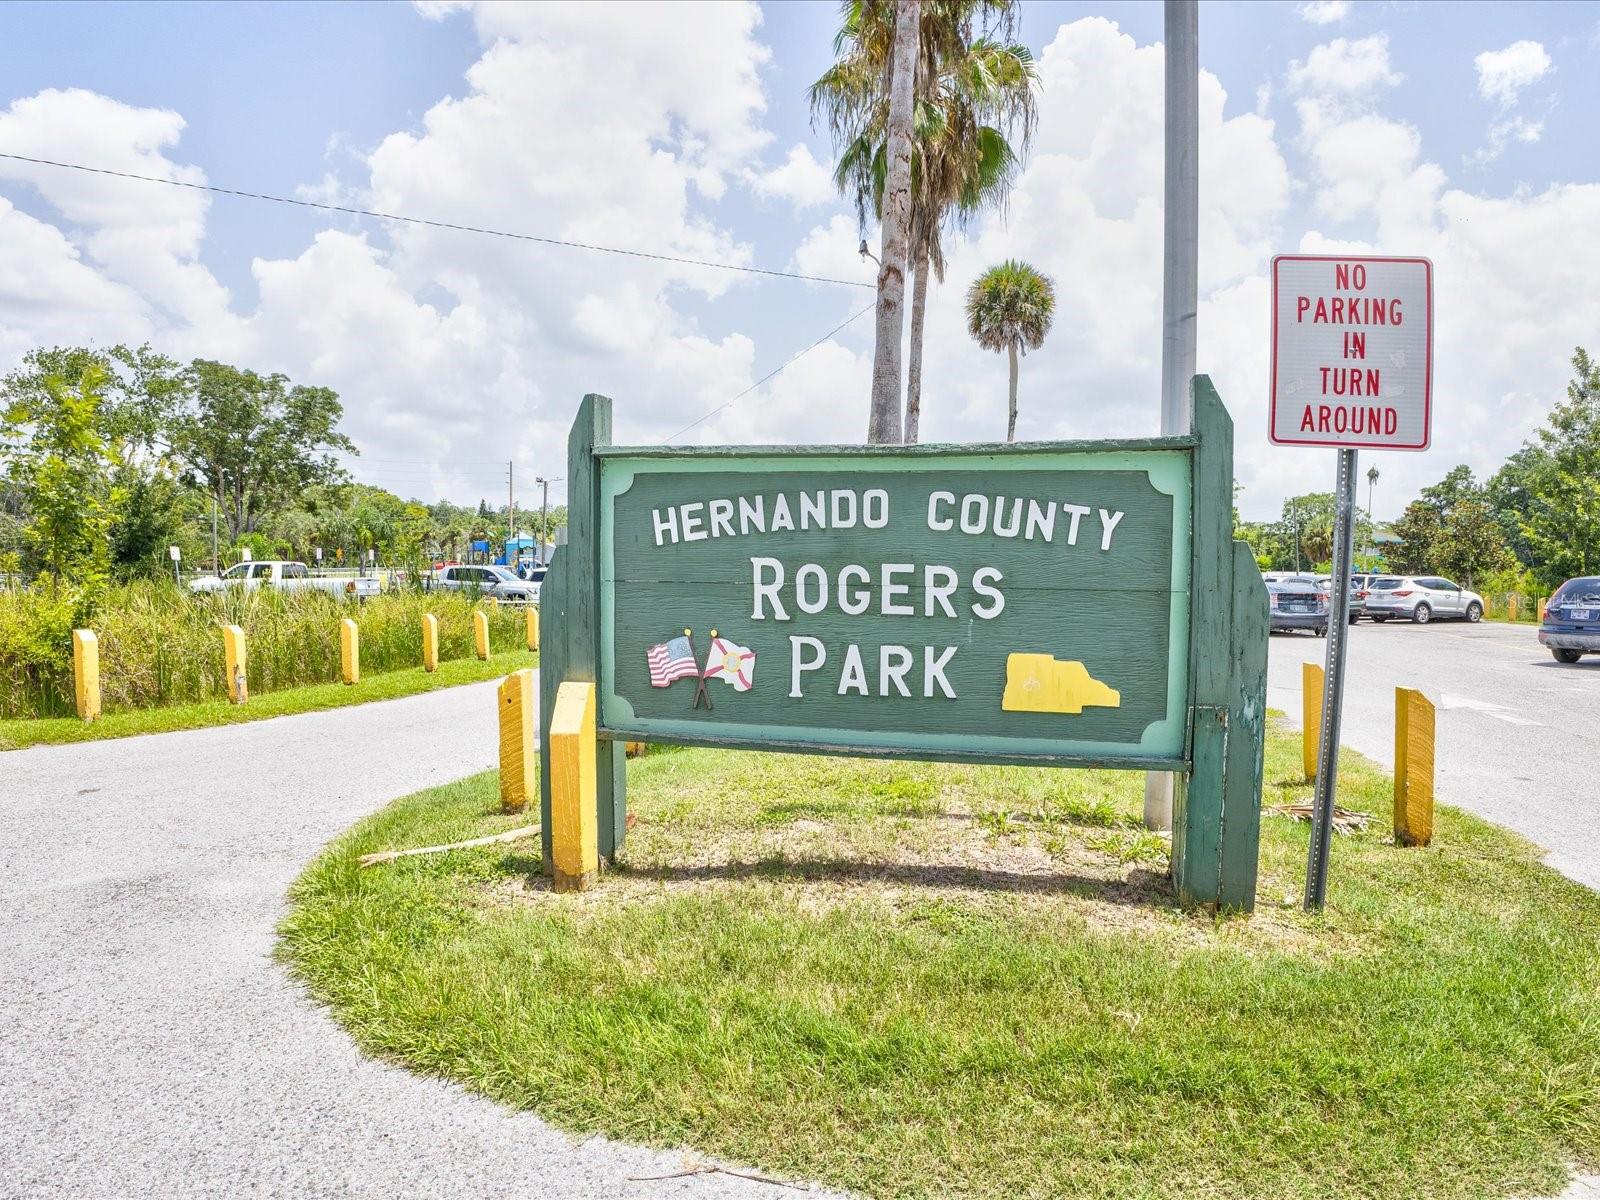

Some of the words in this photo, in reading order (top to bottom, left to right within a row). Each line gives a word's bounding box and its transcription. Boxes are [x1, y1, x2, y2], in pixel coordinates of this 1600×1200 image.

[1335, 263, 1367, 291] NO
[1297, 296, 1403, 326] PARKING
[1343, 331, 1366, 360] IN
[1319, 367, 1380, 397] TURN
[1299, 404, 1398, 436] AROUND
[652, 488, 889, 546] HERNANDO
[927, 491, 1126, 551] COUNTY
[750, 557, 1006, 620] ROGERS
[788, 635, 959, 700] PARK
